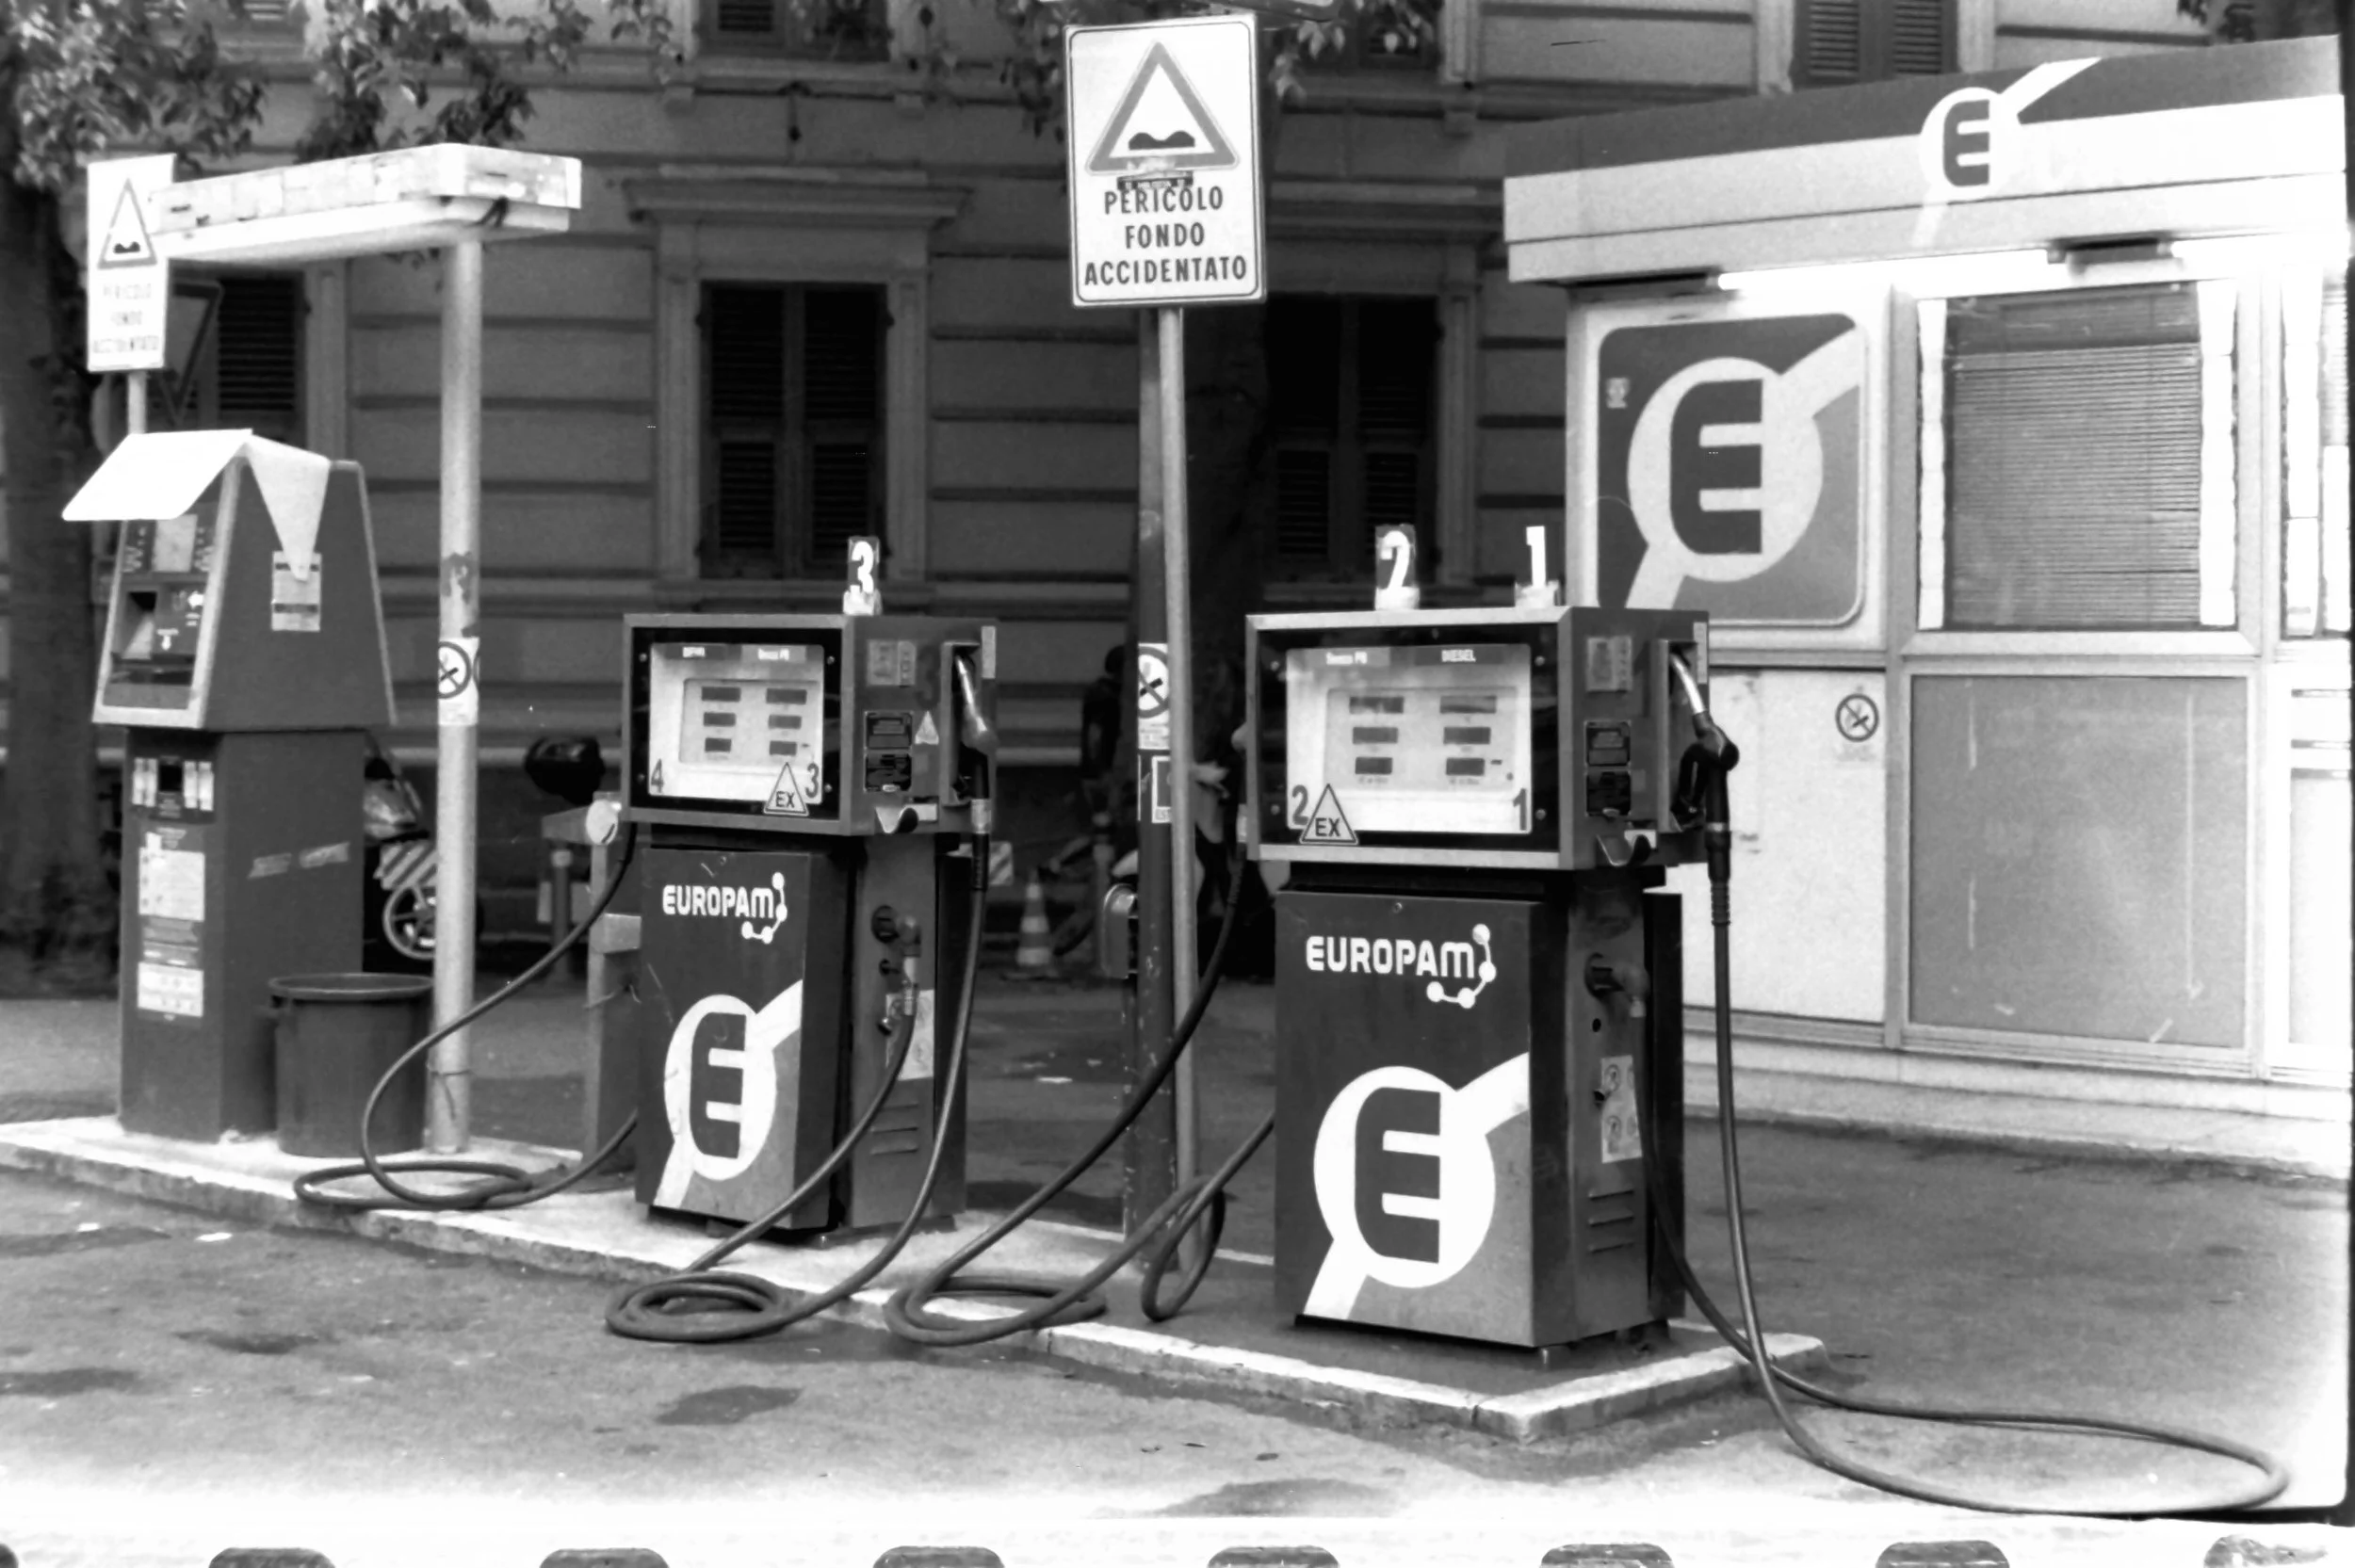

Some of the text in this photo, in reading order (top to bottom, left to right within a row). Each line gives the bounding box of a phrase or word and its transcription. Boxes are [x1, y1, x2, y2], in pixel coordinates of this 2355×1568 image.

[1104, 186, 1224, 215] PERICOLO
[1125, 222, 1205, 249] FONDO
[1084, 255, 1247, 285] ACCIDENTATO
[851, 540, 874, 593] 3
[1380, 529, 1411, 590] 2
[1525, 525, 1547, 587] 1
[1441, 649, 1476, 662] DIESEL
[650, 758, 664, 794] 4
[804, 762, 820, 799] 3
[774, 791, 796, 808] EX
[1291, 784, 1309, 825] 2
[1512, 787, 1528, 831] 1
[1314, 817, 1341, 837] EX
